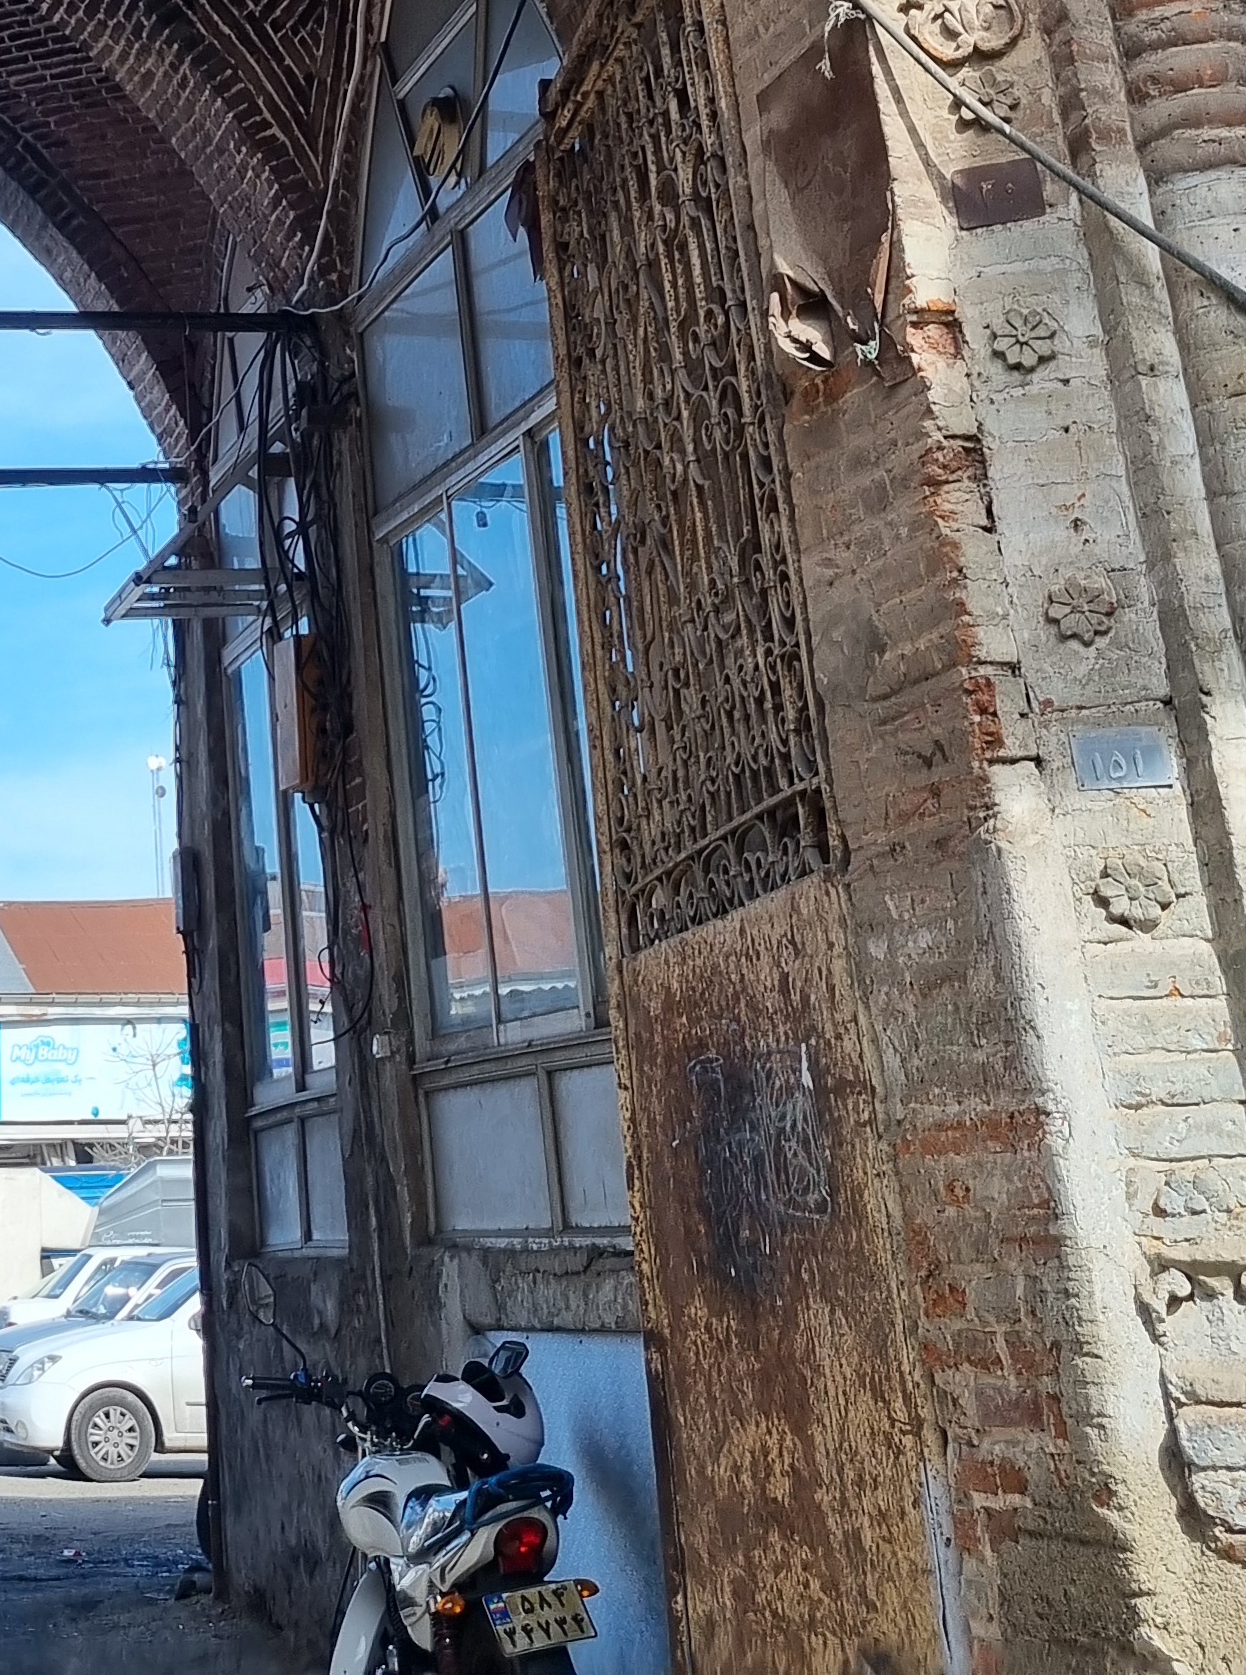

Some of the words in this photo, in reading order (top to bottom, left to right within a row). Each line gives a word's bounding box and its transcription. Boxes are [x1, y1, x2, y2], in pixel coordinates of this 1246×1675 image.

[1091, 749, 1144, 782] ۱۵۱
[11, 1044, 36, 1066] My
[37, 1044, 79, 1066] Baby
[520, 1585, 568, 1614] ۵۸۴
[503, 1613, 585, 1648] ۳۴۷۳۴
